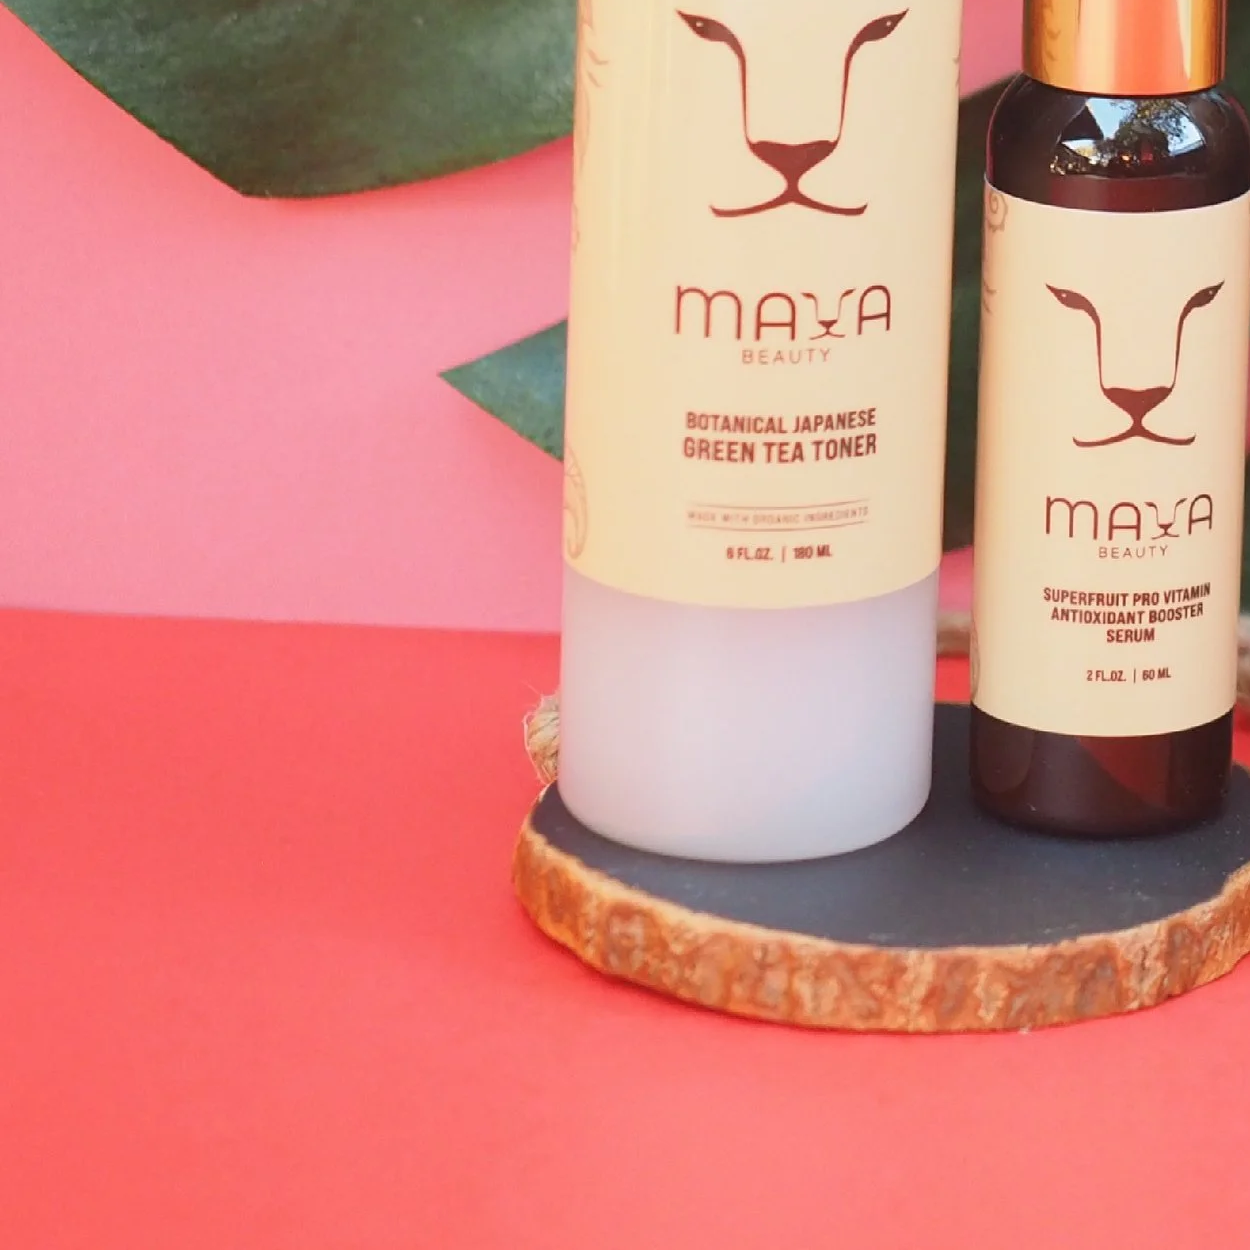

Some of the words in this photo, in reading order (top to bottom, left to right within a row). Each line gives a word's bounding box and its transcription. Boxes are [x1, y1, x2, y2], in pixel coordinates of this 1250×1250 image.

[742, 348, 832, 364] BEAUTY
[686, 411, 788, 434] BOTANICAL
[792, 407, 877, 434] JAPANESE
[683, 437, 755, 463] GREEN
[762, 441, 804, 463] TEA
[812, 433, 877, 461] TONER
[793, 545, 813, 559] 180
[817, 544, 833, 558] ML
[1098, 545, 1169, 559] BEAUTY
[1043, 587, 1129, 607] SUPERFRUIT
[1132, 592, 1160, 607] PRO
[1163, 582, 1211, 604] VITAMIN
[1051, 607, 1146, 625] ANTIOXIDANT
[1148, 601, 1204, 624] BOOSTER
[1106, 627, 1155, 643] SERUM
[1086, 670, 1093, 682] 2
[1142, 669, 1155, 681] 60
[1157, 666, 1172, 679] ML
